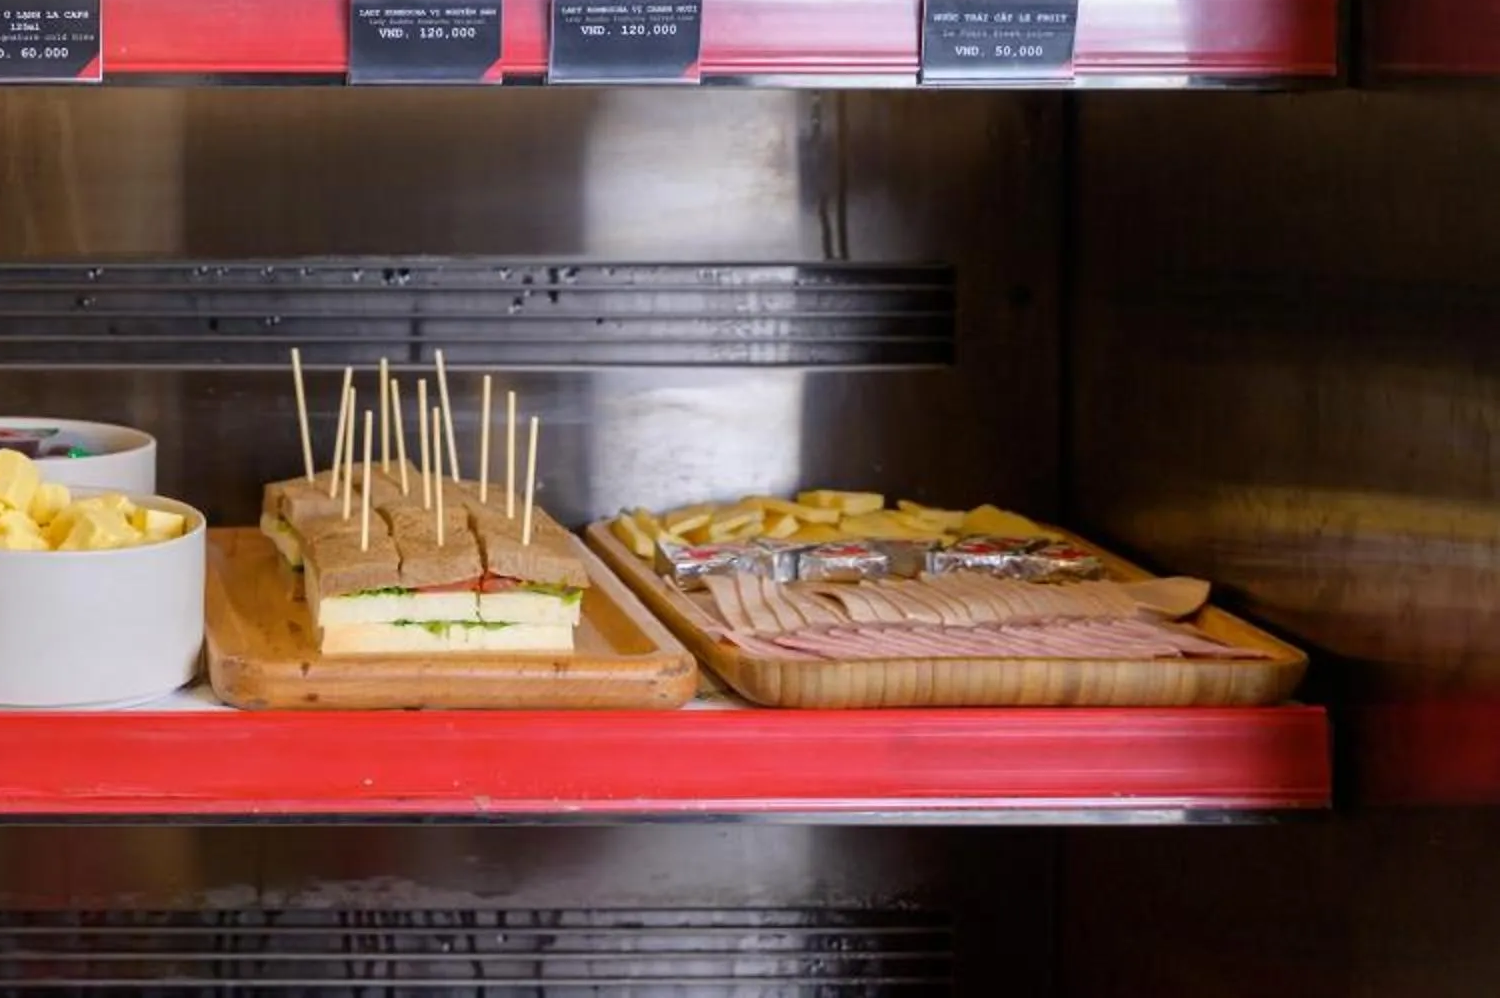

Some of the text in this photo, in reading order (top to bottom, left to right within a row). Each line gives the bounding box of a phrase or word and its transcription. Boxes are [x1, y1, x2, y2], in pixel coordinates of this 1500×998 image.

[378, 27, 477, 39] VND. 120,000
[580, 24, 677, 37] VND. 120,000
[20, 47, 69, 59] 60,000
[995, 45, 1044, 58] 50,000
